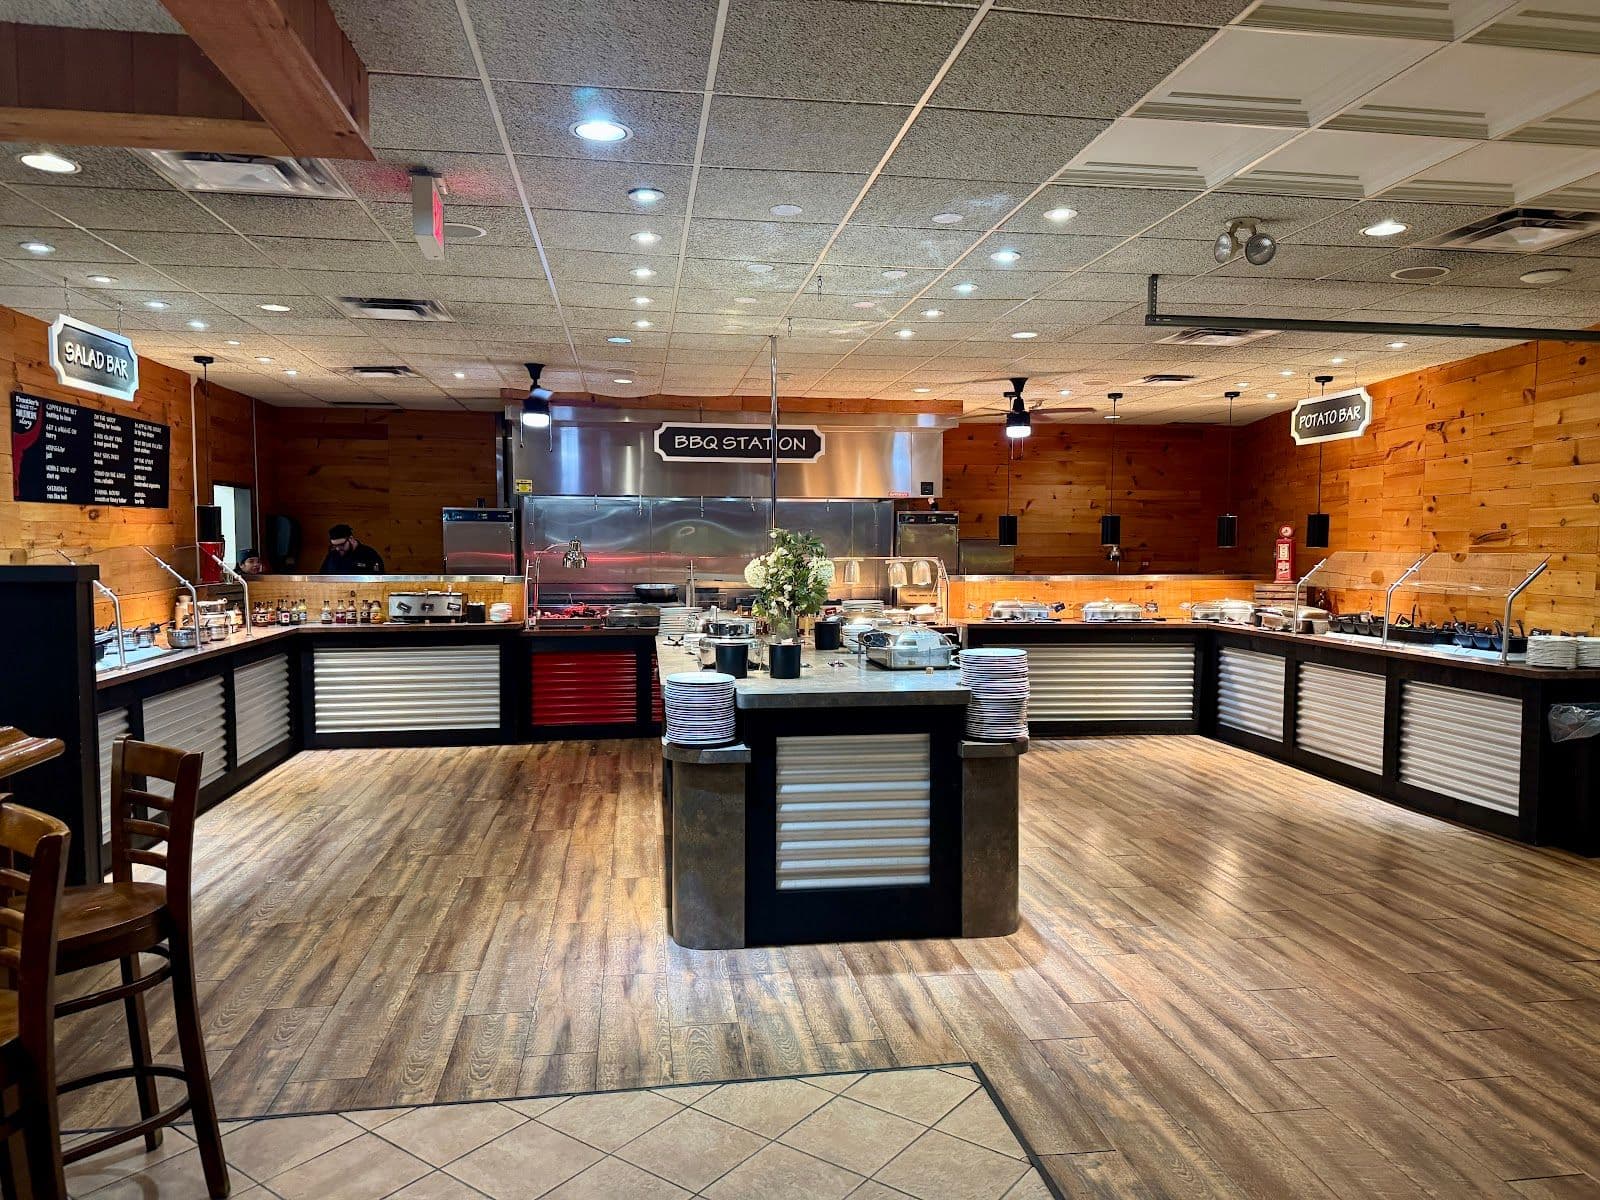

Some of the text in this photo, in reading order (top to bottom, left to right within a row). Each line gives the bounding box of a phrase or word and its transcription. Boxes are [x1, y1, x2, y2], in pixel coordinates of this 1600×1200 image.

[64, 341, 128, 379] SALAD BAR
[1299, 405, 1361, 430] POTATO BAR
[674, 435, 806, 451] BBQ STATON
